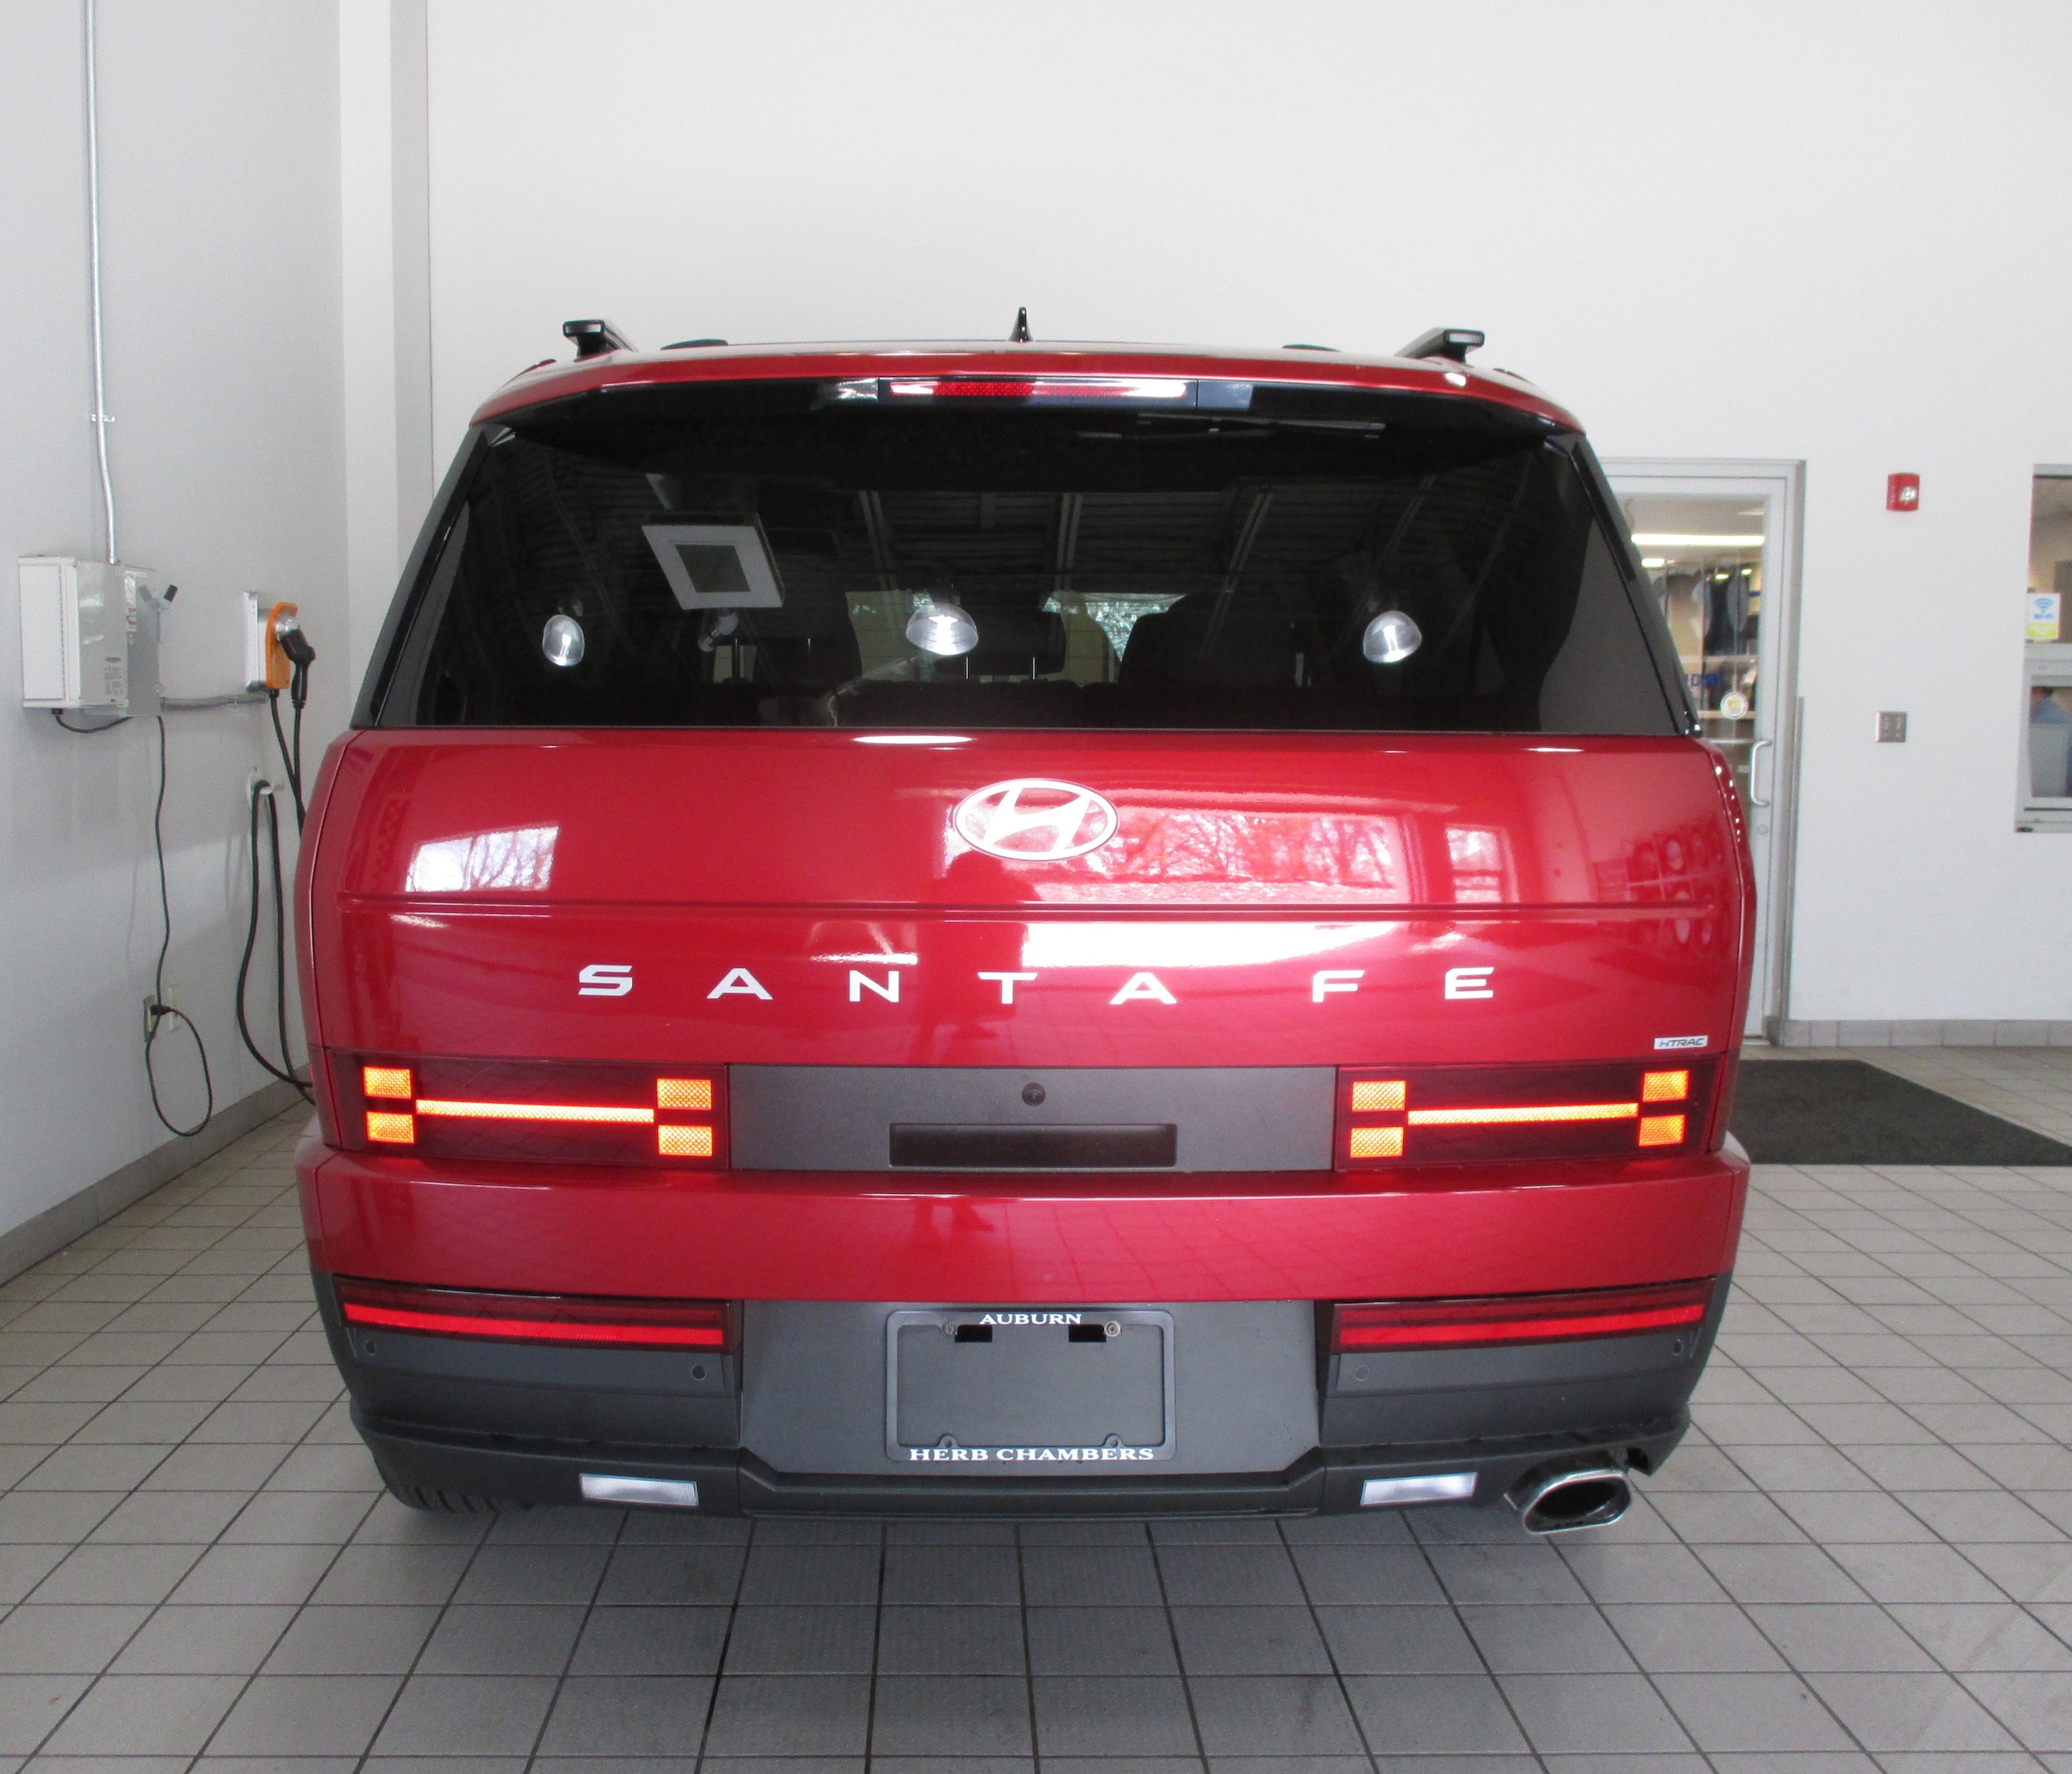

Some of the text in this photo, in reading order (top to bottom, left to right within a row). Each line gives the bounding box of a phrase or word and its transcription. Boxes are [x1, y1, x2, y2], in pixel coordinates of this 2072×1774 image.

[578, 964, 1495, 1005] SANTA FE
[1658, 1037, 1705, 1048] HTRAC
[978, 1313, 1082, 1326] AUBURN
[909, 1448, 1155, 1462] HERB CHAMBERS
